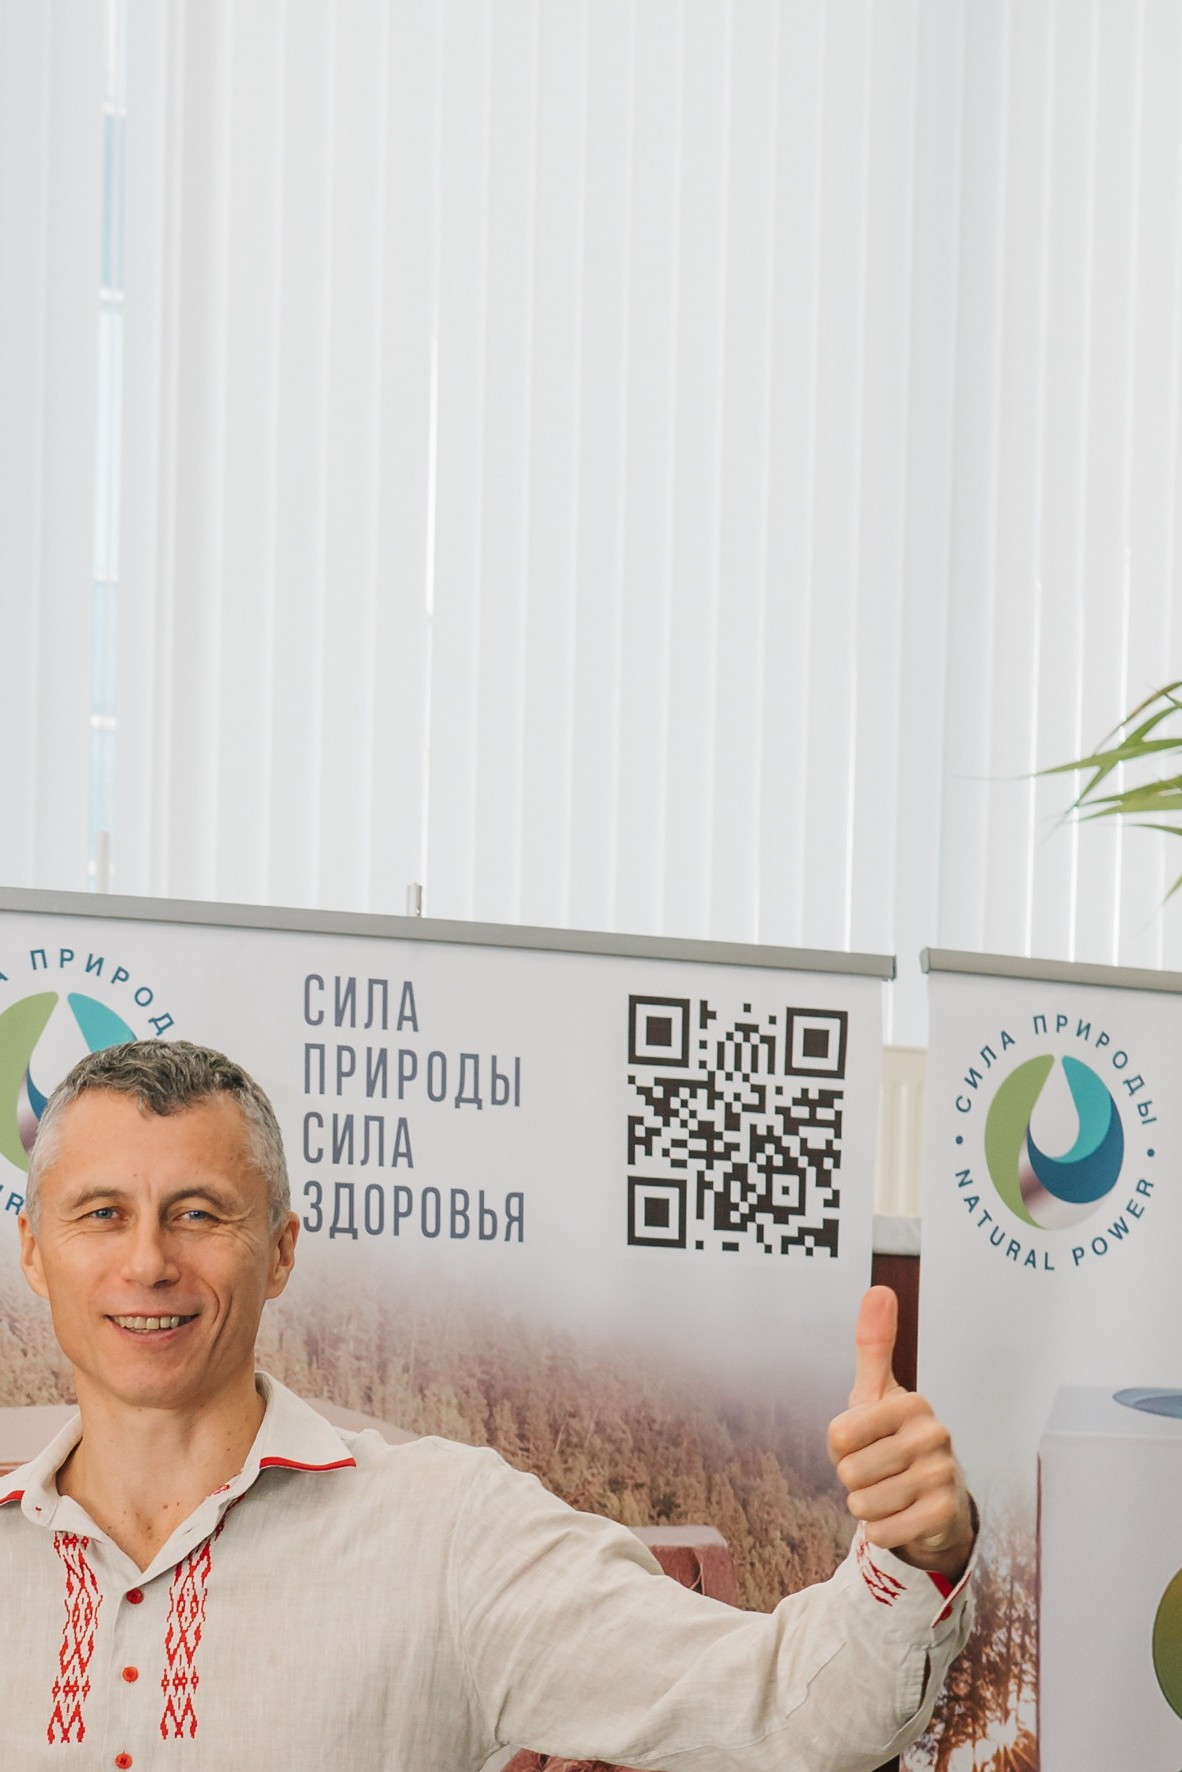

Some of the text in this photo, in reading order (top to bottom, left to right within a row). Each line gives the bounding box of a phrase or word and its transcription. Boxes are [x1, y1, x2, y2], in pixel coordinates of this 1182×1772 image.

[30, 948, 176, 1039] ПРИРОД
[303, 974, 419, 1033] СИЛА
[304, 1043, 521, 1110] ПРИРОДЫ
[955, 1014, 1157, 1125] СИЛА ПРИРОДЫ
[302, 1111, 414, 1168] СИЛА
[302, 1180, 525, 1243] ЗДОРОВЬЯ
[955, 1169, 1155, 1271] NATURAL POWER
